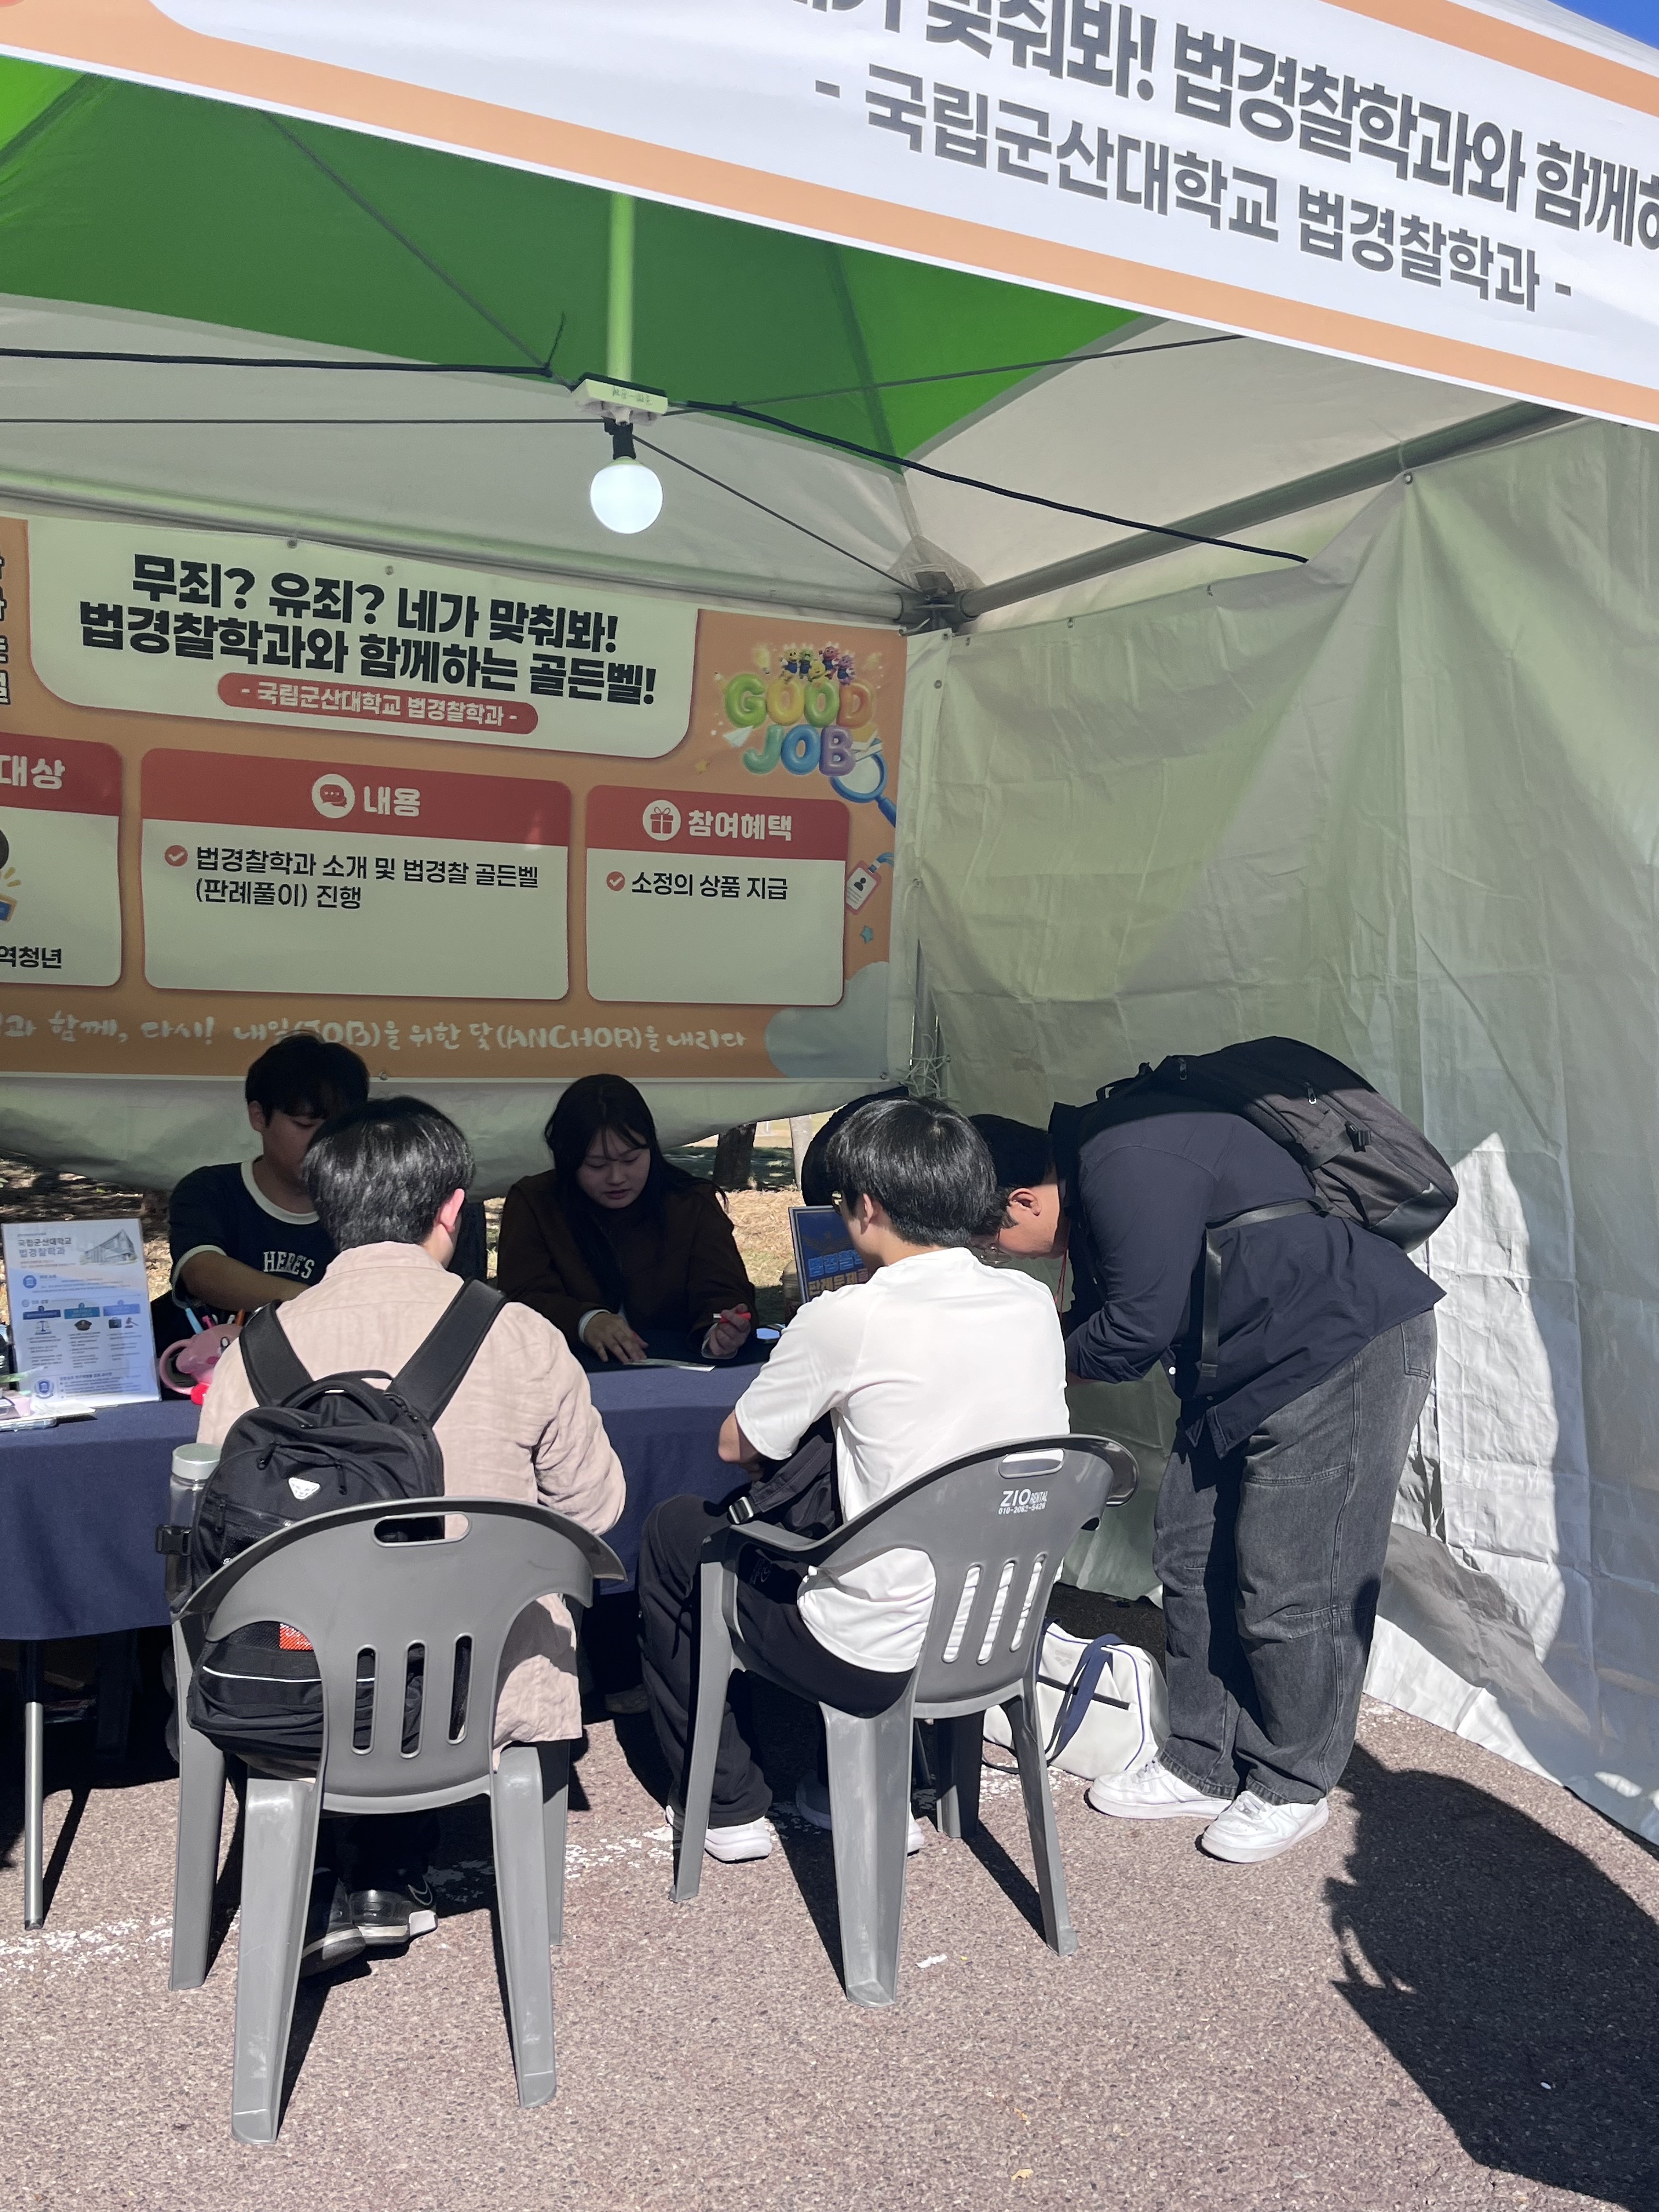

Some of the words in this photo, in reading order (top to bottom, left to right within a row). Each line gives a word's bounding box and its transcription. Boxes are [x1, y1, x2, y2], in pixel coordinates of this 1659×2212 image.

[1174, 23, 1525, 212] 법경찰학과와
[865, 64, 1278, 242] 국립군산대학교
[1299, 184, 1539, 312] 법경찰학과
[132, 554, 255, 610] 무죄?
[269, 572, 385, 624] 유죄?
[398, 588, 478, 637] 네가
[490, 599, 618, 653] 맞춰봐!
[80, 601, 348, 674] 법경찰학과와
[359, 633, 517, 692] 함께하는
[530, 653, 656, 706] 골든벨!
[257, 682, 401, 716] 국립군산대학교
[408, 696, 504, 726] 법경찰학과
[725, 673, 874, 729] GOOD
[742, 724, 856, 776] JOB
[364, 786, 421, 817] 내용
[688, 810, 792, 841] 참여혜택
[196, 846, 316, 877] 법경찰학과
[323, 854, 367, 879] 소개
[375, 857, 395, 881] 및
[403, 859, 469, 884] 법경찰
[475, 863, 538, 888] 골든벨
[631, 872, 693, 896] 소정의
[699, 874, 740, 898] 상품
[746, 877, 788, 900] 지급
[195, 878, 307, 909] (판례풀이)
[316, 884, 362, 910] 진행
[48, 1010, 128, 1043] 함께,
[409, 1022, 460, 1049] 위한
[667, 1029, 747, 1050] 내리다
[19, 1247, 65, 1257] 법경찰학과
[1000, 1488, 1031, 1506] ZIO
